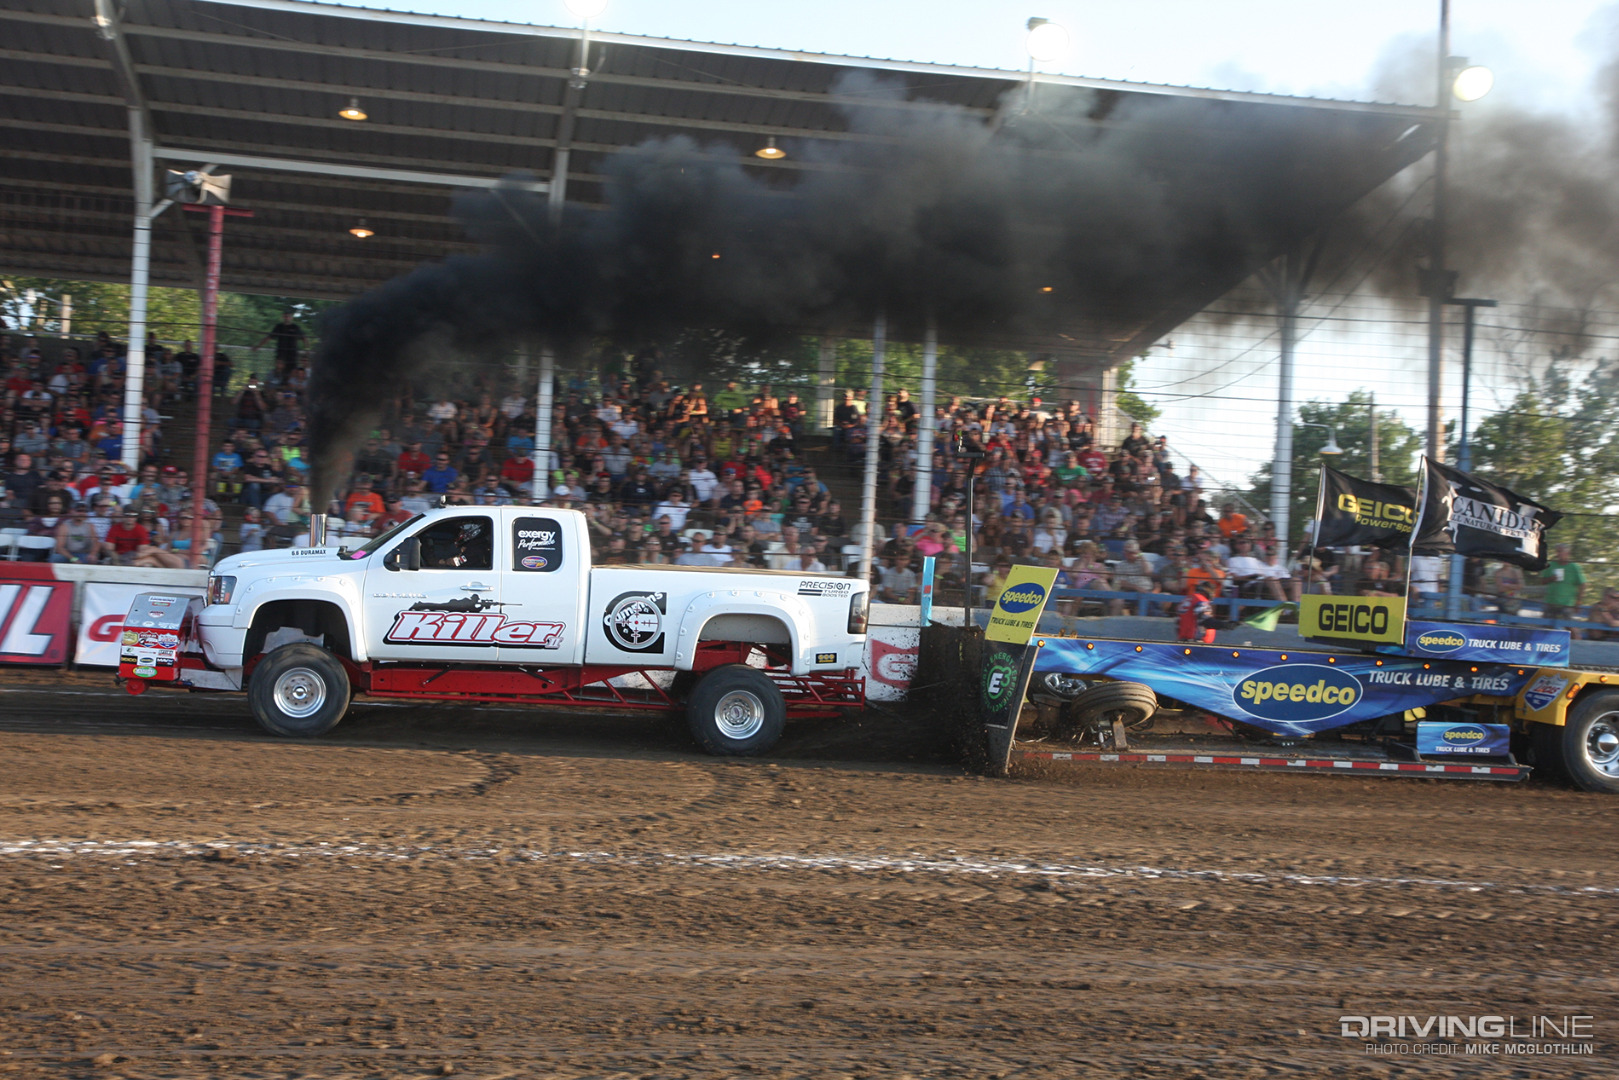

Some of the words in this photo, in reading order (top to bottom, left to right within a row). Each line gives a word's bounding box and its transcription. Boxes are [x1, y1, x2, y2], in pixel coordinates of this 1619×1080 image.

[1354, 514, 1412, 533] Powerspo
[1465, 517, 1502, 534] NATURAL
[518, 530, 556, 542] exergy
[799, 580, 851, 591] PRECISION
[1002, 590, 1043, 605] speedco
[603, 591, 664, 627] Cummns
[386, 611, 564, 645] Killer
[991, 616, 1005, 625] TRUCK
[1005, 619, 1016, 627] LUBE
[1020, 620, 1034, 629] TIRES
[1318, 603, 1389, 635] GEICO
[1419, 635, 1464, 647] speedco
[1468, 638, 1498, 649] TRUCK
[1499, 641, 1522, 651] LUBE
[1524, 642, 1532, 651] &
[1535, 643, 1562, 653] TIRES
[1368, 670, 1412, 685] TRUCK
[1415, 673, 1451, 688] LUBE
[1454, 676, 1465, 688] &
[1471, 676, 1510, 691] TIRES
[1240, 679, 1356, 706] speedco
[1444, 730, 1484, 740] speedco
